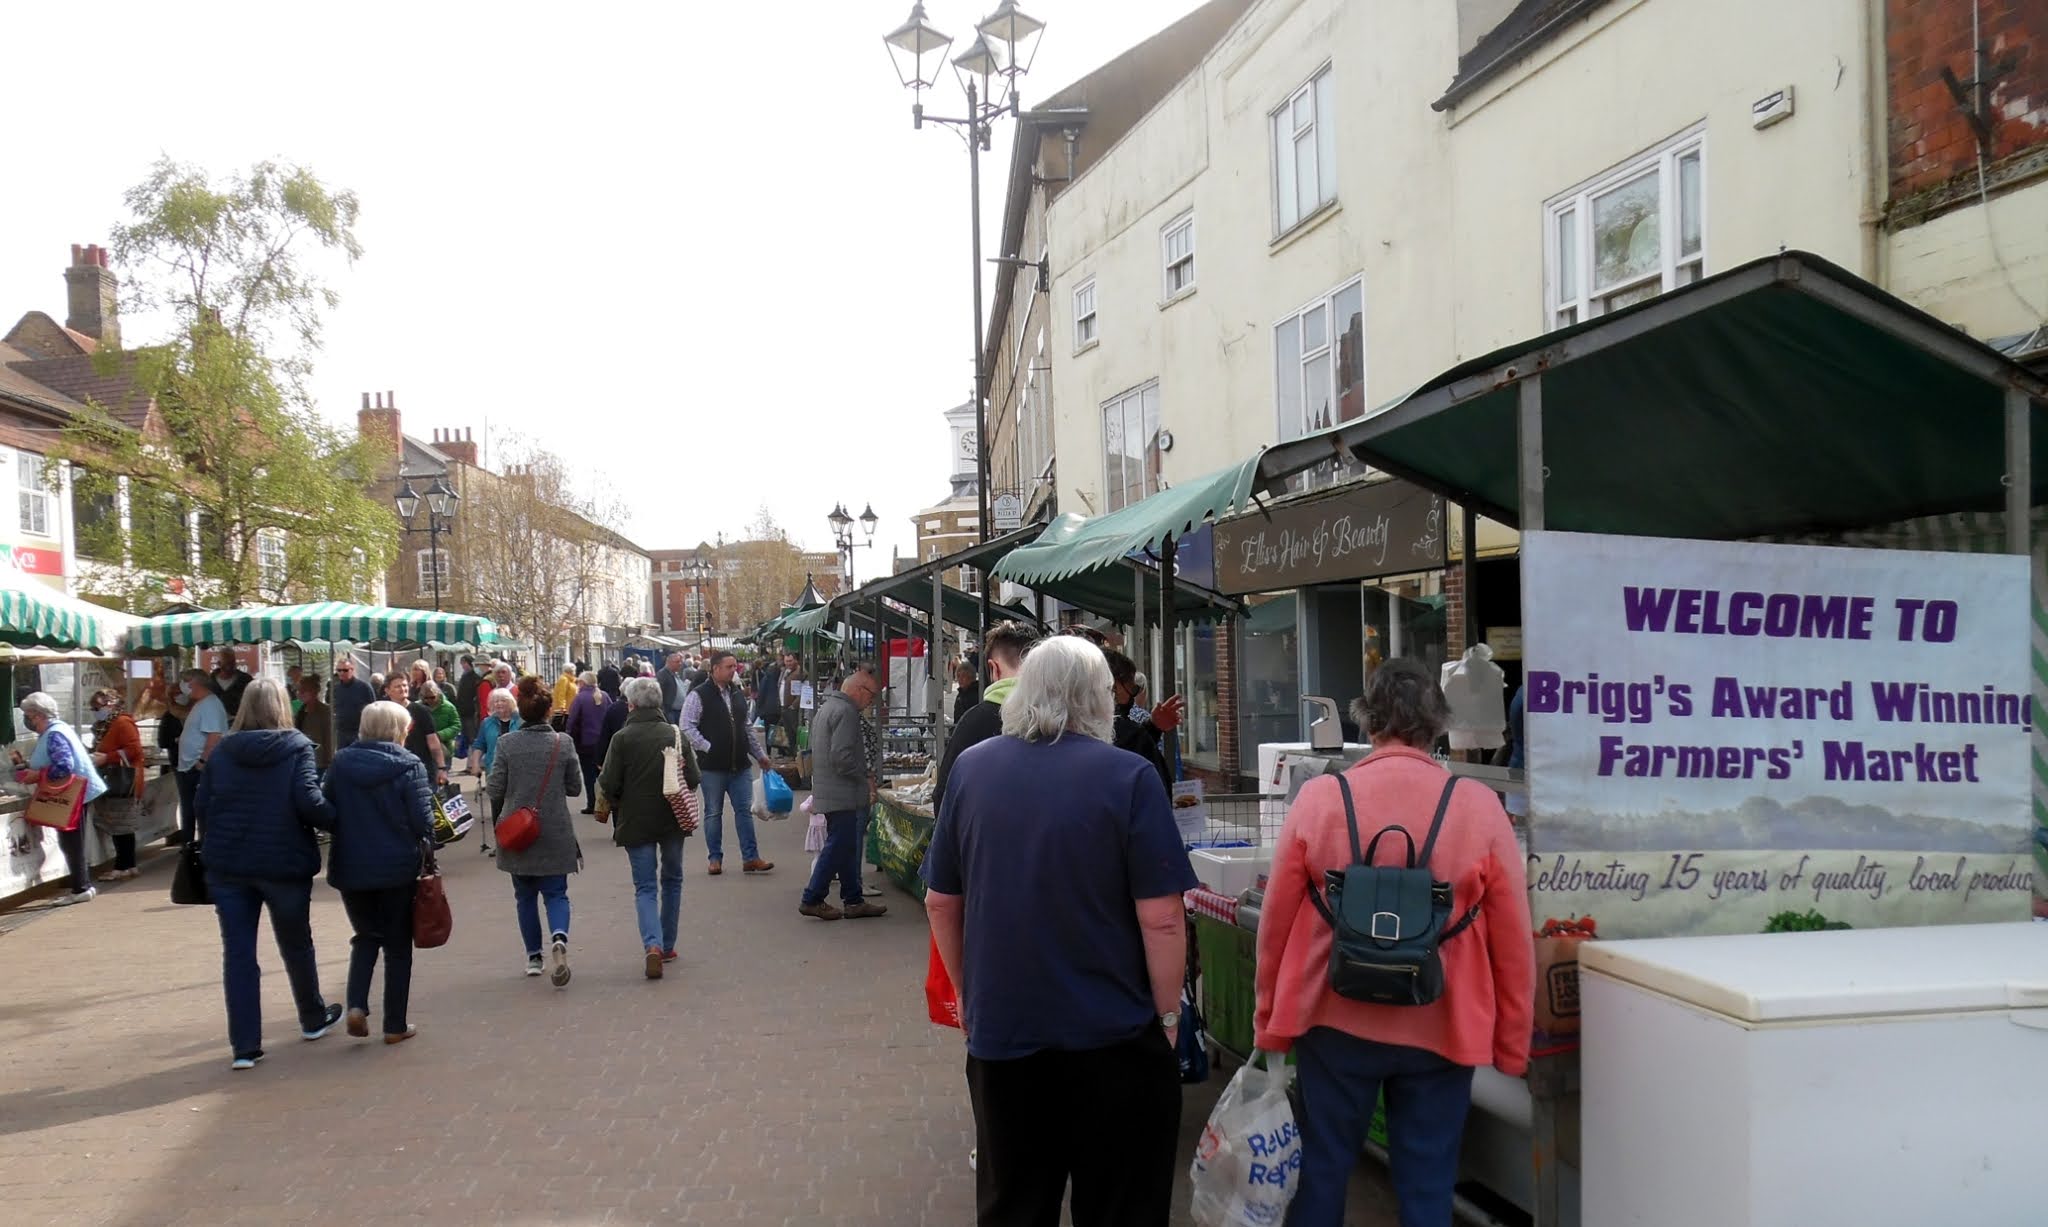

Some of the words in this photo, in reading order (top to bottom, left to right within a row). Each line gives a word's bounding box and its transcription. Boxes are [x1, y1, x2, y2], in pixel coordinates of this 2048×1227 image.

[1278, 528, 1310, 574] Hair
[1312, 520, 1328, 568] &
[1332, 515, 1390, 566] Beauty
[1623, 586, 1875, 640] WELCOME
[1895, 598, 1958, 643] TO
[1526, 670, 1694, 724] Brigg's
[1711, 676, 1854, 721] Award
[1597, 735, 1804, 780] Farmers'
[1823, 740, 1980, 783] Market
[1660, 853, 1704, 890] 15
[1708, 868, 1768, 900] years
[1779, 854, 1809, 891] of
[1908, 856, 1966, 892] local
